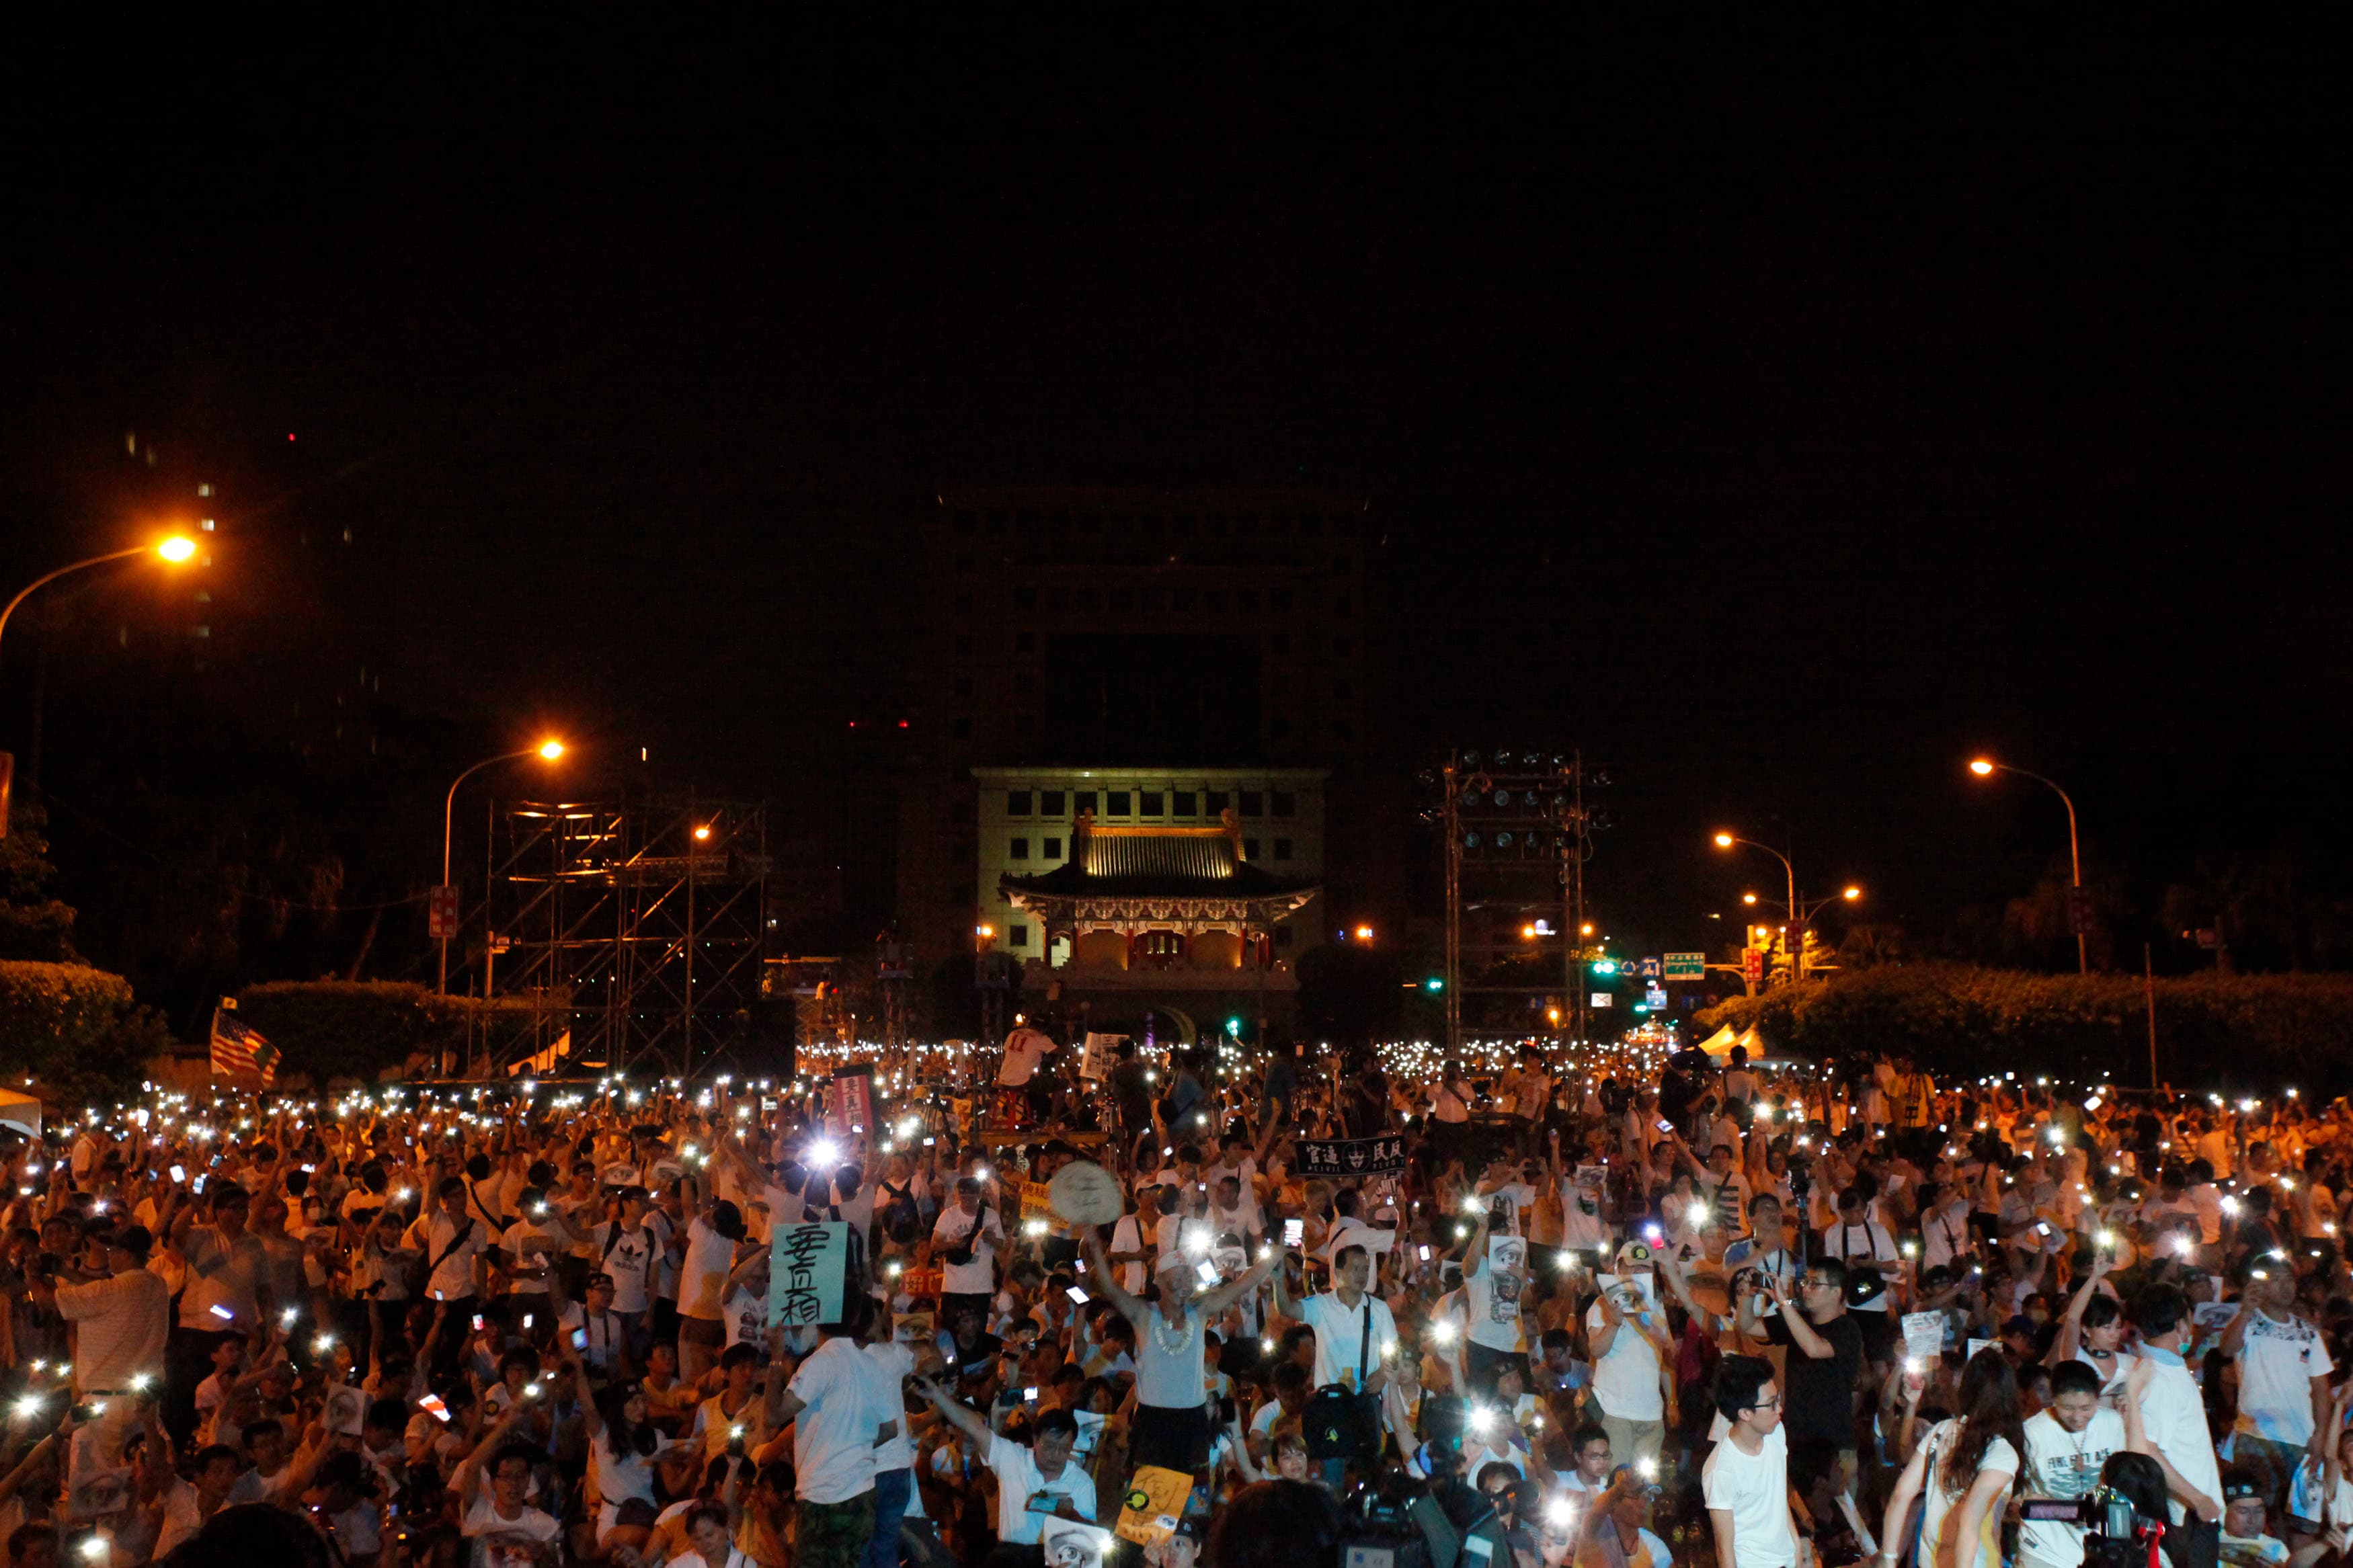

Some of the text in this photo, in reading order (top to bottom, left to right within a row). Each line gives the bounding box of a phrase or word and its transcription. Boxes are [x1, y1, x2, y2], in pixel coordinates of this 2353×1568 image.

[1009, 1034, 1027, 1052] 11
[845, 1077, 862, 1126] 要真相
[1306, 1144, 1340, 1165] 官逼
[781, 1224, 830, 1325] 要真相
